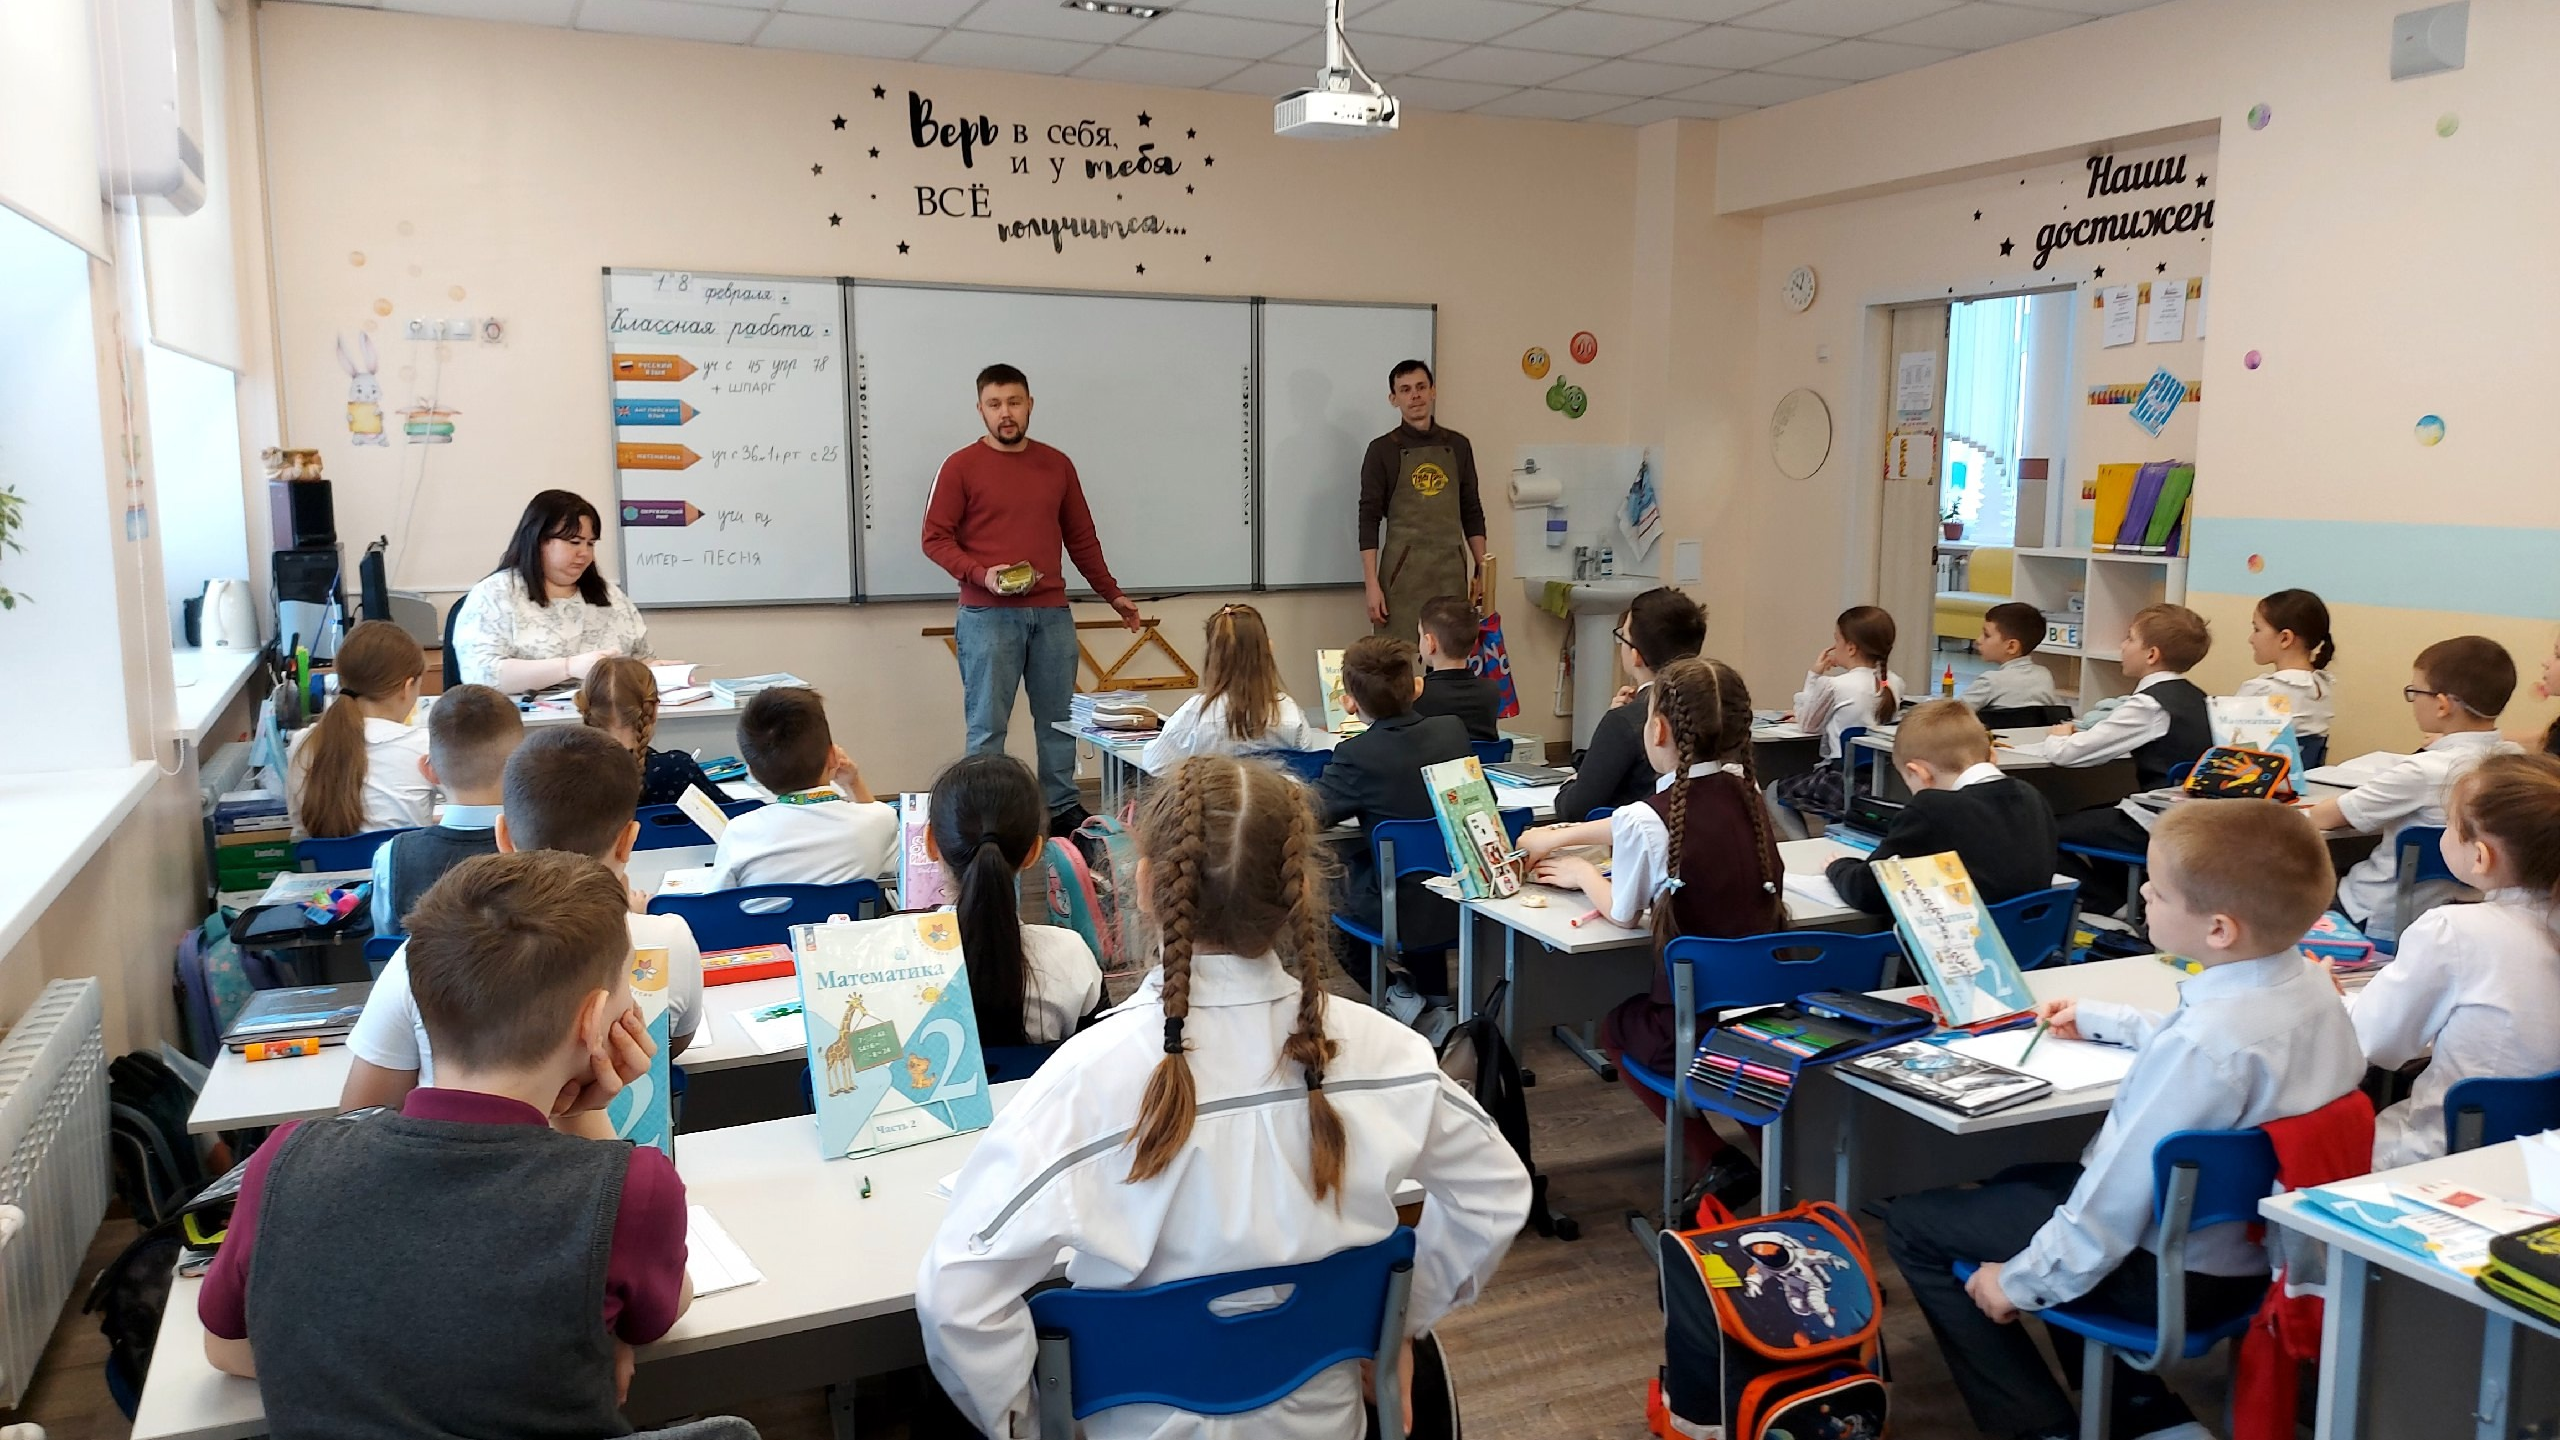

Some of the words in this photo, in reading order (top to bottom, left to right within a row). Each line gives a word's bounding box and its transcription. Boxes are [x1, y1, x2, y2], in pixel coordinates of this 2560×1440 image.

[908, 91, 999, 168] Верь
[1013, 124, 1028, 144] в
[1047, 119, 1119, 150] себя,
[1010, 155, 1030, 174] и
[1050, 156, 1066, 183] у
[1085, 143, 1182, 180] тебя
[2086, 154, 2187, 199] Наши
[914, 183, 992, 218] ВСЁ
[998, 214, 1188, 254] получится...
[610, 307, 716, 334] Классная
[812, 355, 830, 372] 78
[728, 382, 777, 395] ШПАРГ
[703, 550, 761, 566] ПЕСНЯ
[816, 963, 945, 991] Математика
[919, 1018, 978, 1101] 2
[875, 1123, 908, 1133] Часть
[911, 1119, 917, 1128] 2
